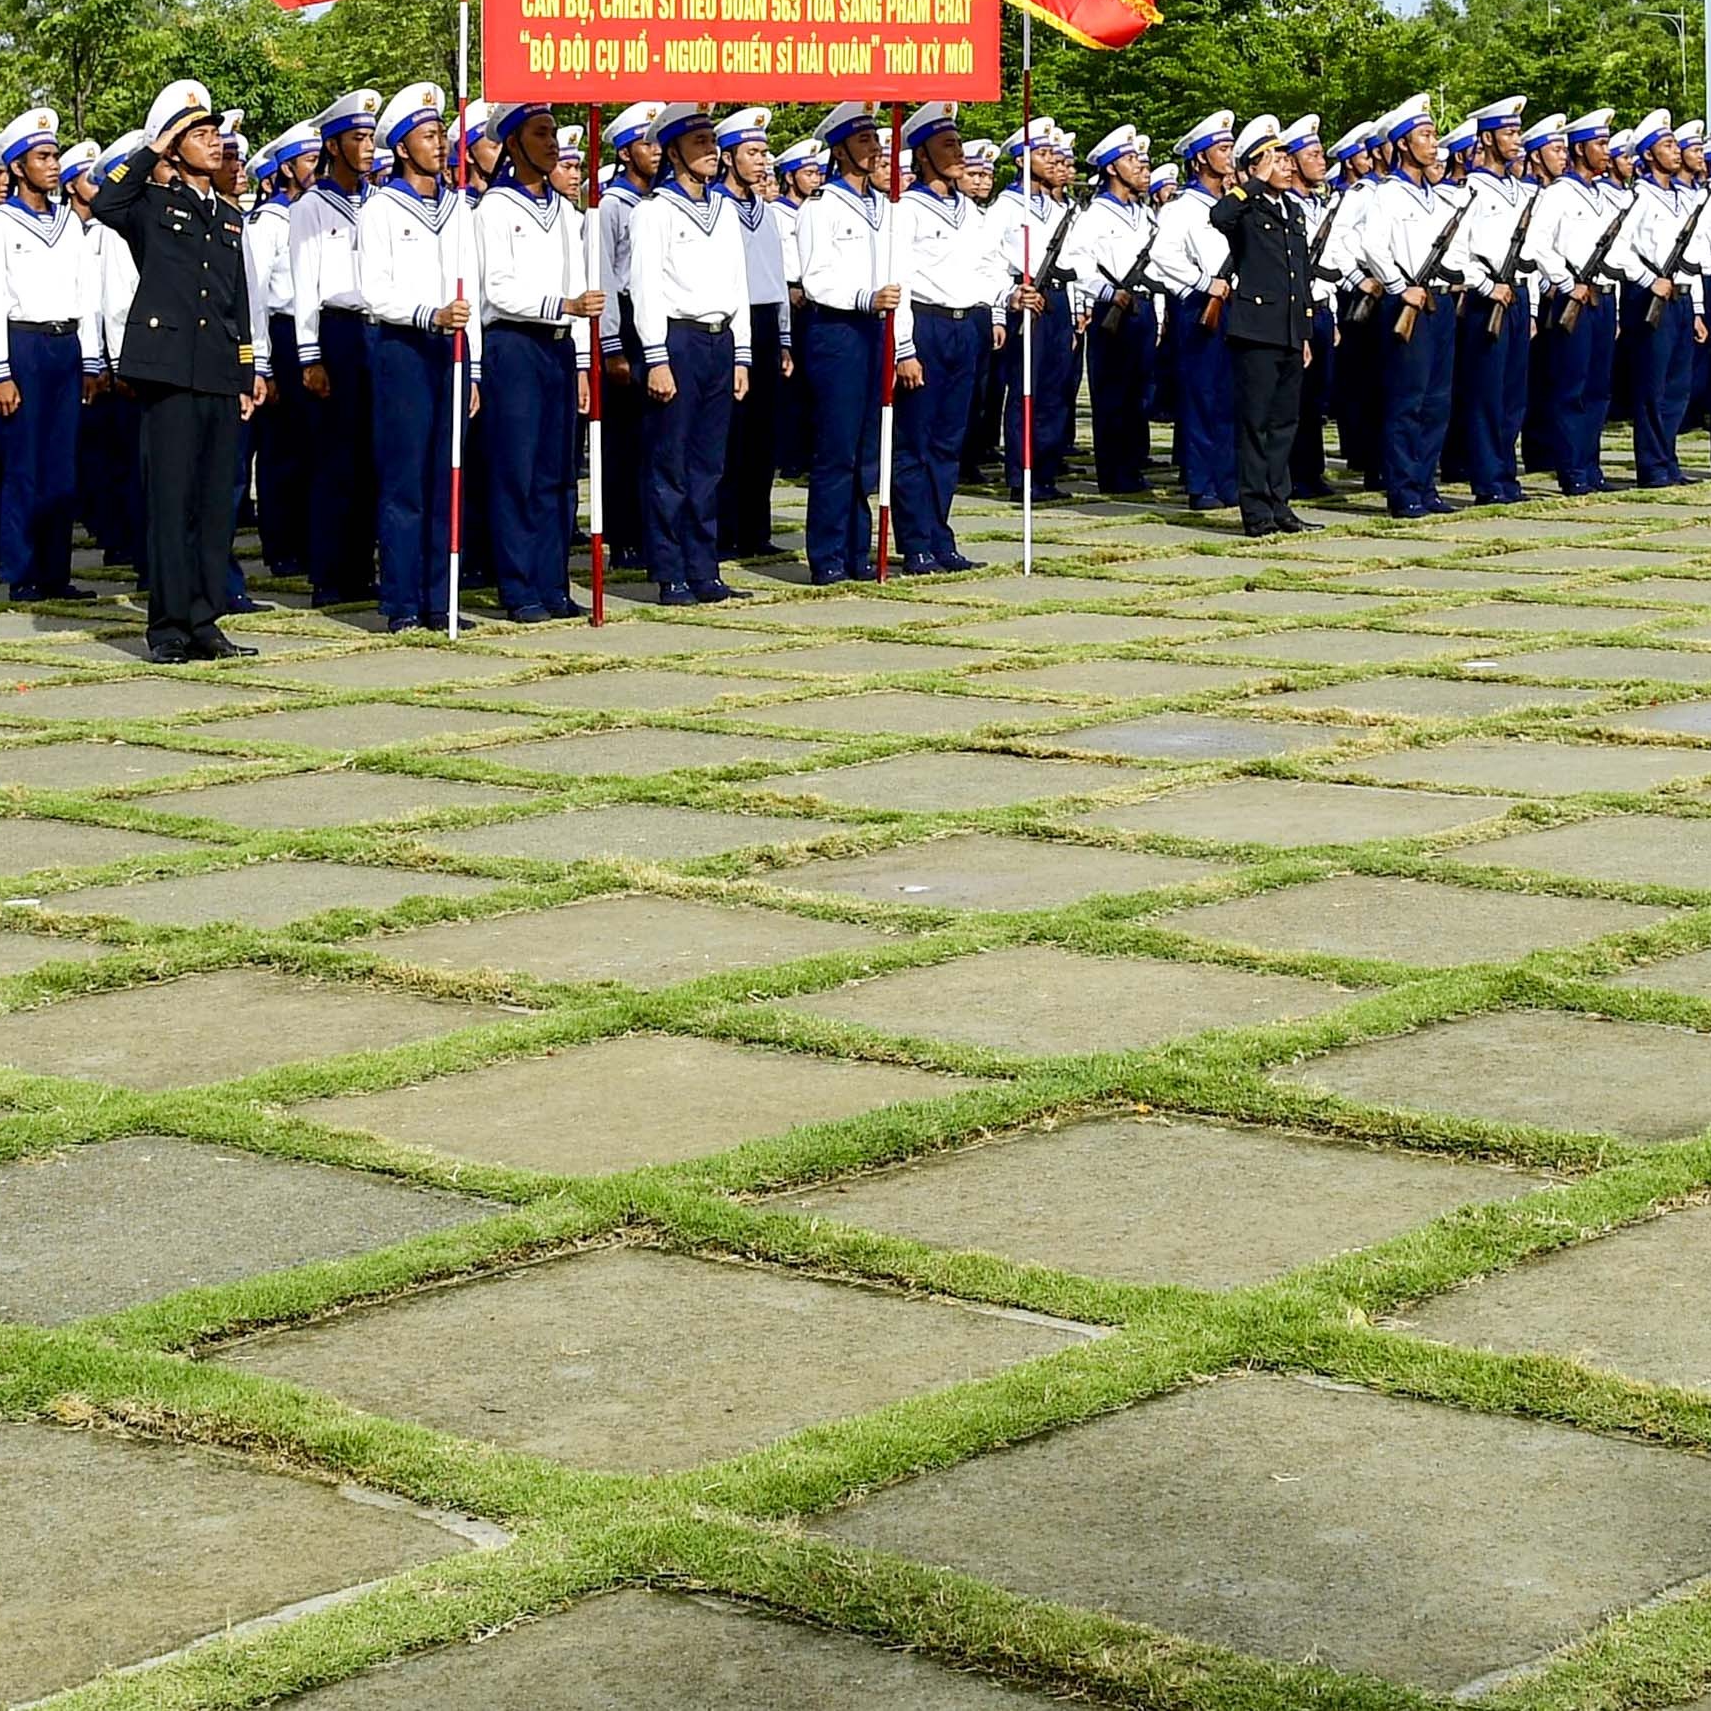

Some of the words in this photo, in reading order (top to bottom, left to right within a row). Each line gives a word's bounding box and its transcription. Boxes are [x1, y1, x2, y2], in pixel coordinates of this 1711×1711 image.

[558, 32, 591, 80] ĐỘI
[594, 38, 620, 81] CỤ
[664, 32, 718, 74] NGƯỜI
[721, 31, 773, 74] CHIẾN
[775, 35, 795, 74] SĨ
[796, 31, 825, 75] HẢI
[883, 35, 918, 75] THỜI
[920, 36, 942, 75] KỲ
[944, 36, 974, 75] MỚI
